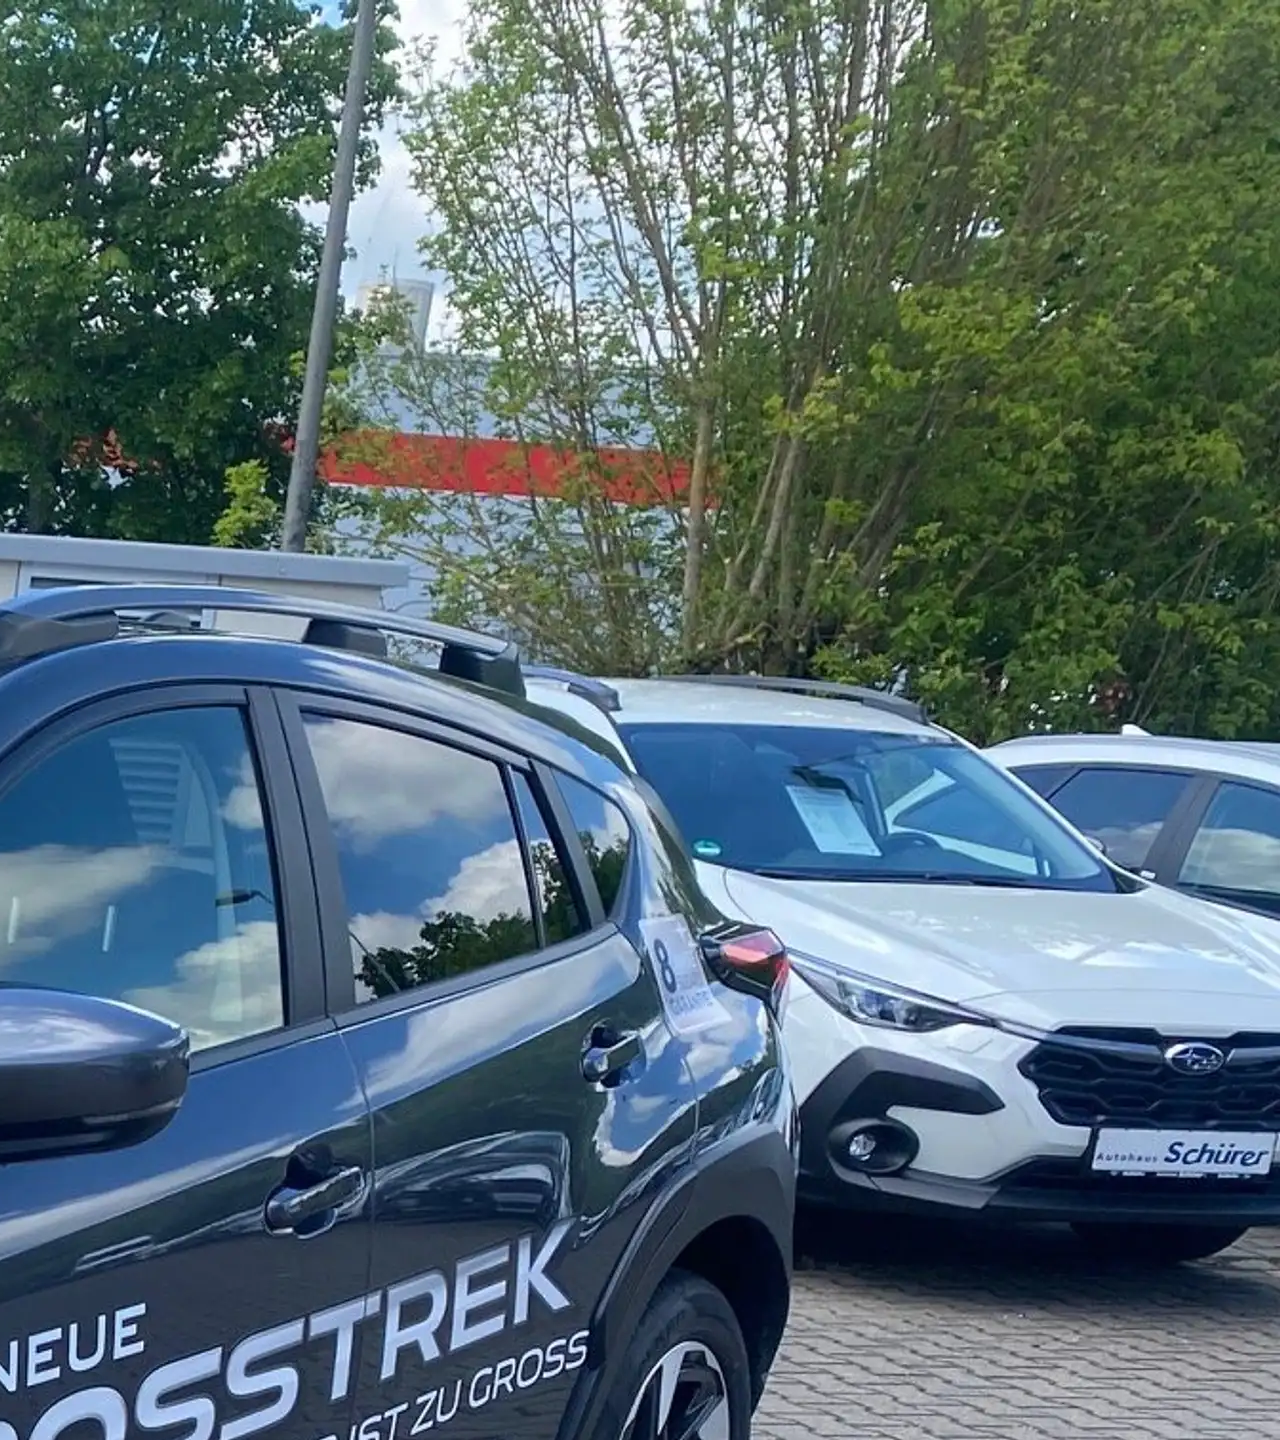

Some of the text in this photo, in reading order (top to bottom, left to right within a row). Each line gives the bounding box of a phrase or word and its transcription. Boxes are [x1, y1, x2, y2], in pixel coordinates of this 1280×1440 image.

[654, 938, 677, 993] 8
[1096, 1141, 1269, 1167] Autohaus Schürer
[409, 1379, 462, 1437] ZU
[468, 1330, 591, 1408] GROSS
